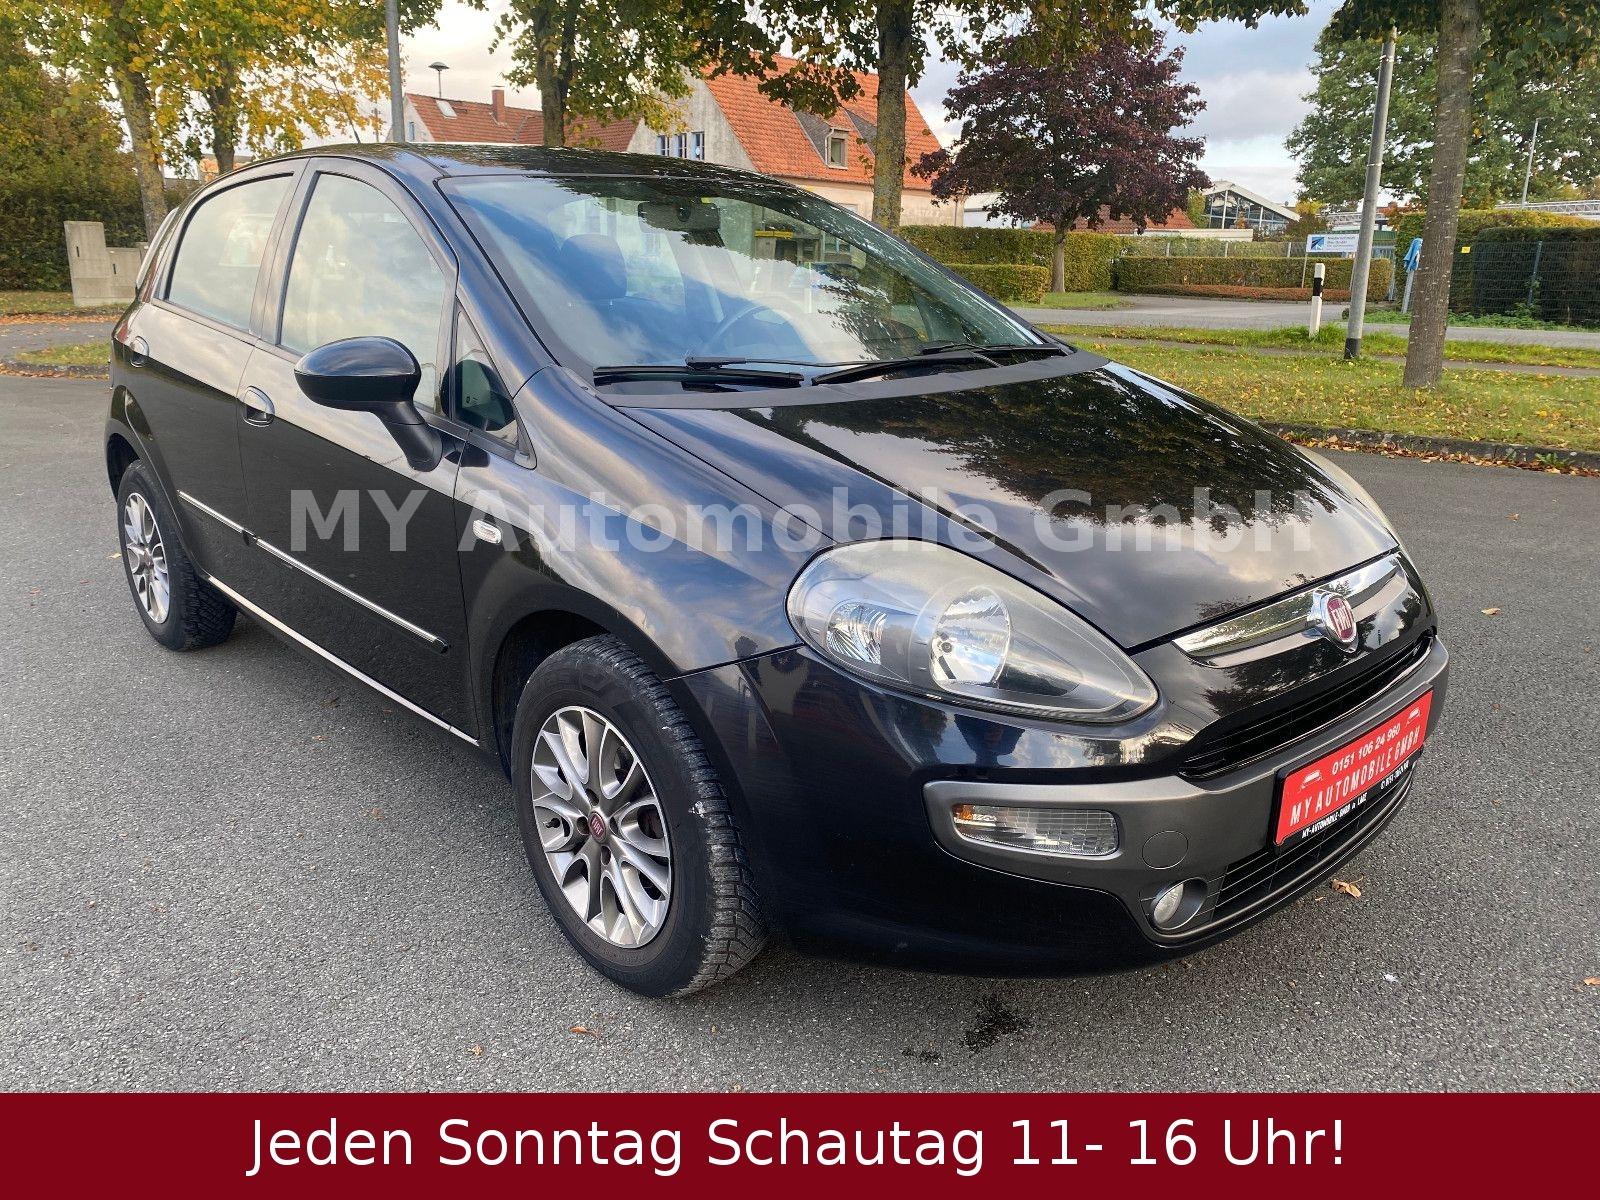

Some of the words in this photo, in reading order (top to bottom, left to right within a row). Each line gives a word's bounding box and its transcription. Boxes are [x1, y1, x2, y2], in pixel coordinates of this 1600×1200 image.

[1290, 796, 1312, 827] MY
[1315, 747, 1393, 813] AUTOMOBILE
[1394, 725, 1420, 761] GMBH
[1331, 752, 1355, 776] 0151
[1358, 740, 1374, 760] 106
[1374, 733, 1386, 750] 24
[1387, 723, 1401, 742] 960
